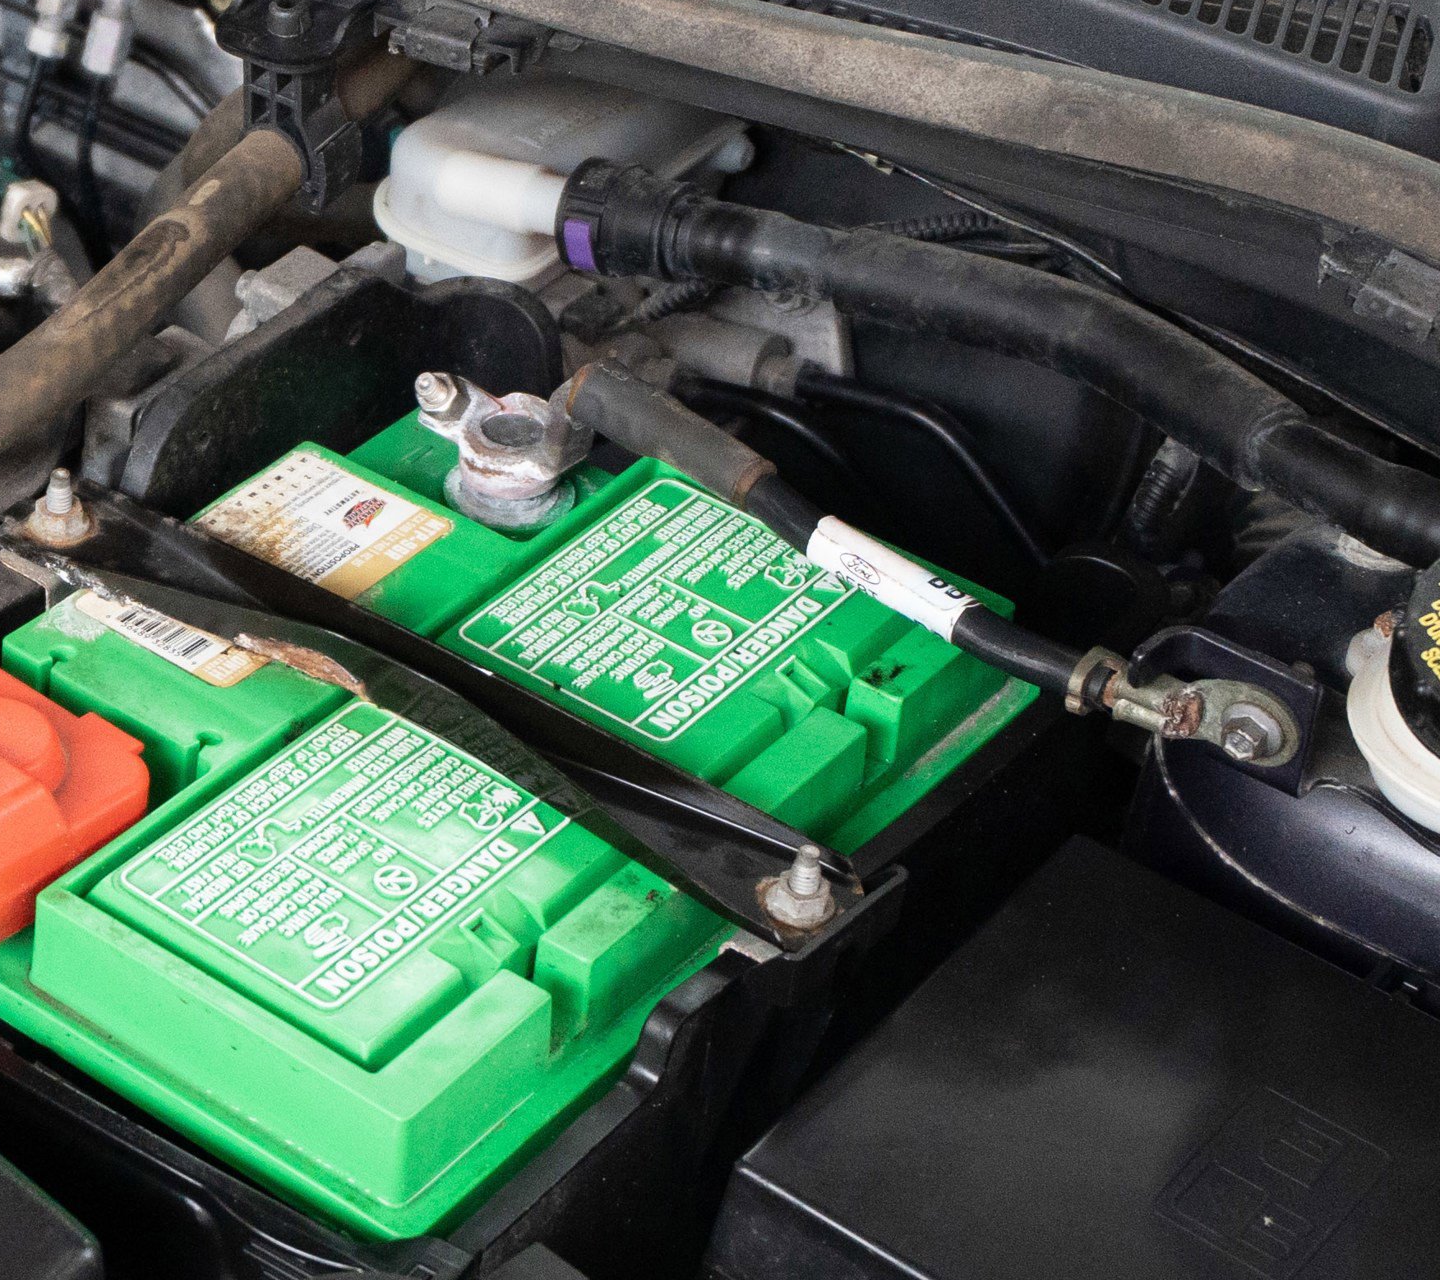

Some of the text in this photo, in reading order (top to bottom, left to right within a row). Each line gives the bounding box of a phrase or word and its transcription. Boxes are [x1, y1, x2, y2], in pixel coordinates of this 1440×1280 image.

[321, 489, 362, 516] AUTOMOTIVE
[651, 498, 710, 543] WITH WATER
[309, 543, 361, 578] PROPOSITION
[498, 502, 667, 628] KEEP OUT OF REACH OF CHILDREN.
[614, 505, 725, 589] FLUSH EYES IMMEDIATELY
[660, 516, 746, 582] BLINDNESS OR INJURY.
[681, 523, 762, 584] GASES CAN CAUSE
[717, 530, 775, 576] EXPLOSIVE
[723, 538, 789, 589] SHIELD EYES
[615, 583, 660, 617] SMOKING
[634, 590, 674, 620] FLAMES
[648, 598, 688, 628] SPARKS
[686, 601, 710, 618] NO
[508, 608, 566, 650] HELP FAST.
[517, 615, 581, 664] GET MEDICAL
[548, 614, 619, 669] SEVERE BURNS.
[569, 622, 634, 672] BLINDNESS OR
[569, 630, 650, 690] ACID CAN CAUSE
[606, 637, 665, 684] SULFURIC
[647, 594, 823, 731] DANGER/POISON
[342, 725, 409, 773] WITH WATER
[164, 728, 363, 872] KEEP OUT OF REACH OF CHILDREN.
[296, 733, 424, 828] FLUSH EYES IMMEDIATELY
[368, 754, 460, 823] GASES CAN CAUSE
[408, 763, 475, 813] EXPLOSIVE
[414, 770, 490, 828] SHIELD EYES
[293, 821, 344, 859] SMOKING
[313, 830, 359, 864] FLAMES
[328, 839, 374, 874] SPARKS
[369, 843, 397, 863] NO
[174, 850, 240, 898] HELP FAST.
[180, 859, 255, 914] GET MEDICAL
[234, 867, 312, 926] BLINDNESS OR
[234, 876, 328, 948] ACID CAN CAUSE
[275, 885, 344, 938] SULFURIC
[313, 836, 520, 996] DANGER/POISON
